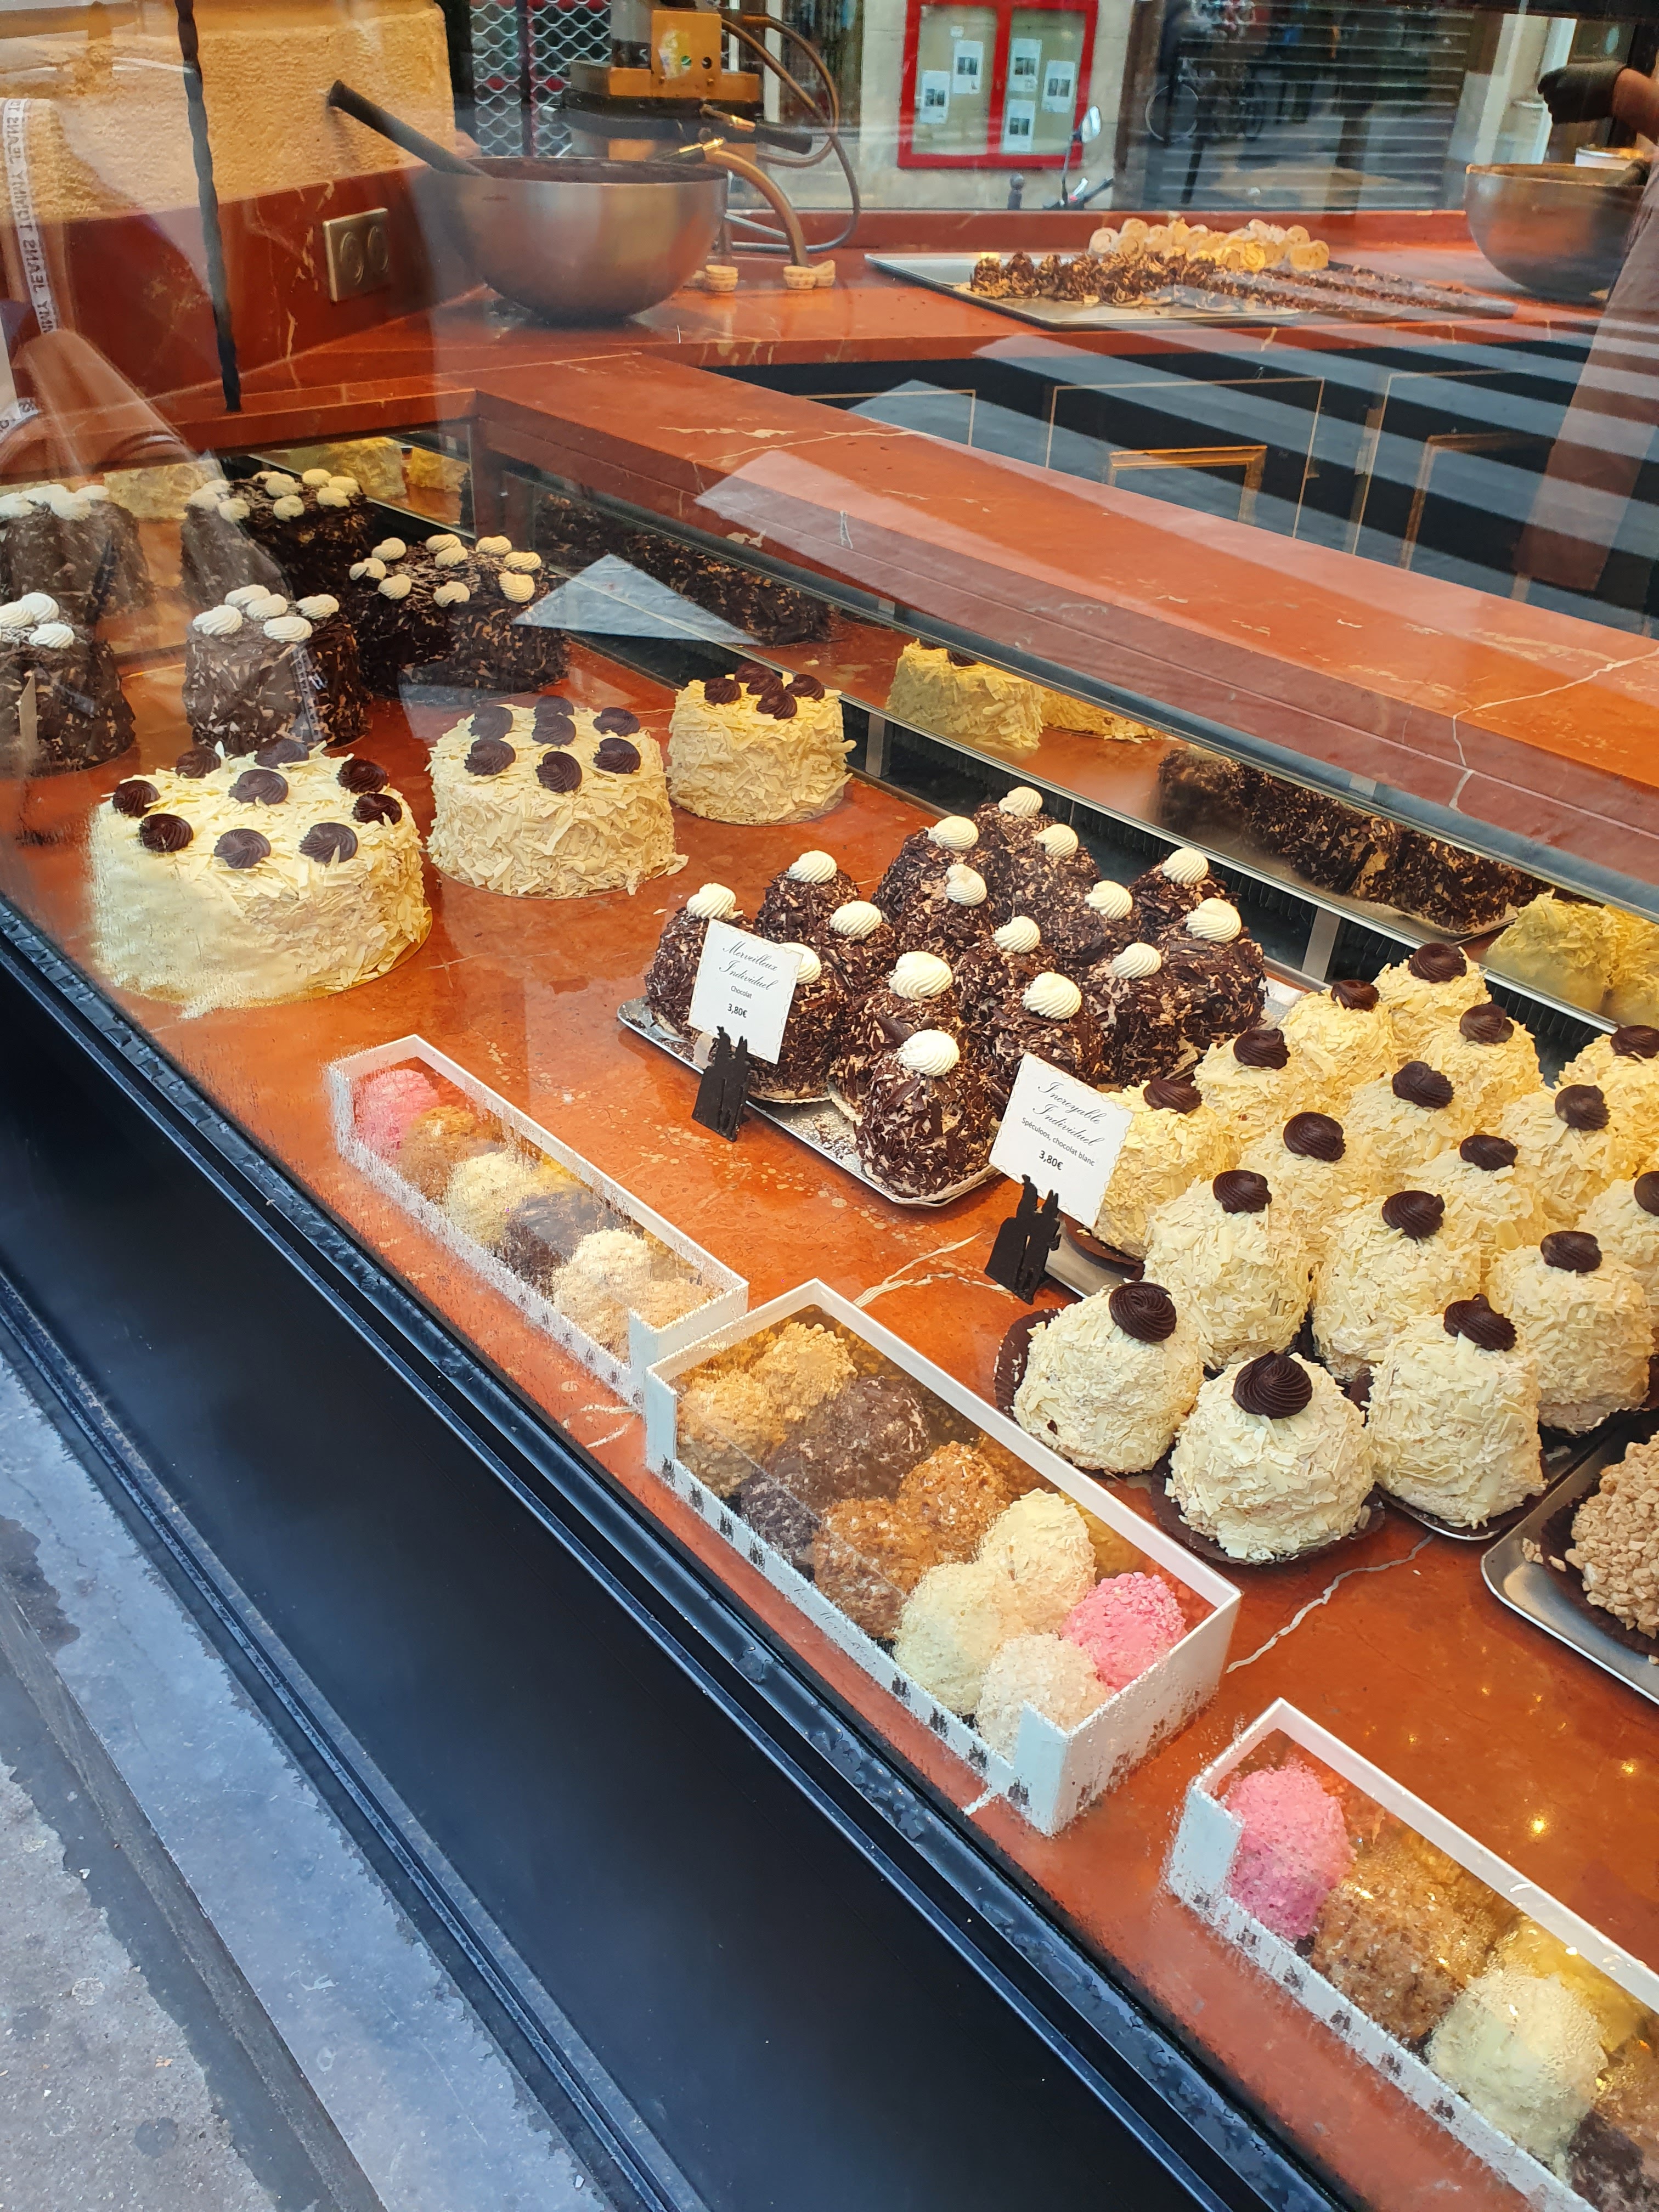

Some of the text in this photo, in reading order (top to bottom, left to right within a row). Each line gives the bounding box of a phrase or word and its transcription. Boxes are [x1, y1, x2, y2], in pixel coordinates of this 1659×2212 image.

[722, 940, 778, 972] Merveilleux
[719, 960, 779, 990] Individuel
[730, 985, 753, 1000] Chocolat
[727, 1003, 748, 1018] 3,80€
[1037, 1081, 1108, 1125] Incroyable
[1032, 1103, 1105, 1147] Individuel
[1021, 1117, 1096, 1167] Spéculoos, chocolat blanc
[1038, 1150, 1064, 1171] 3,80€
